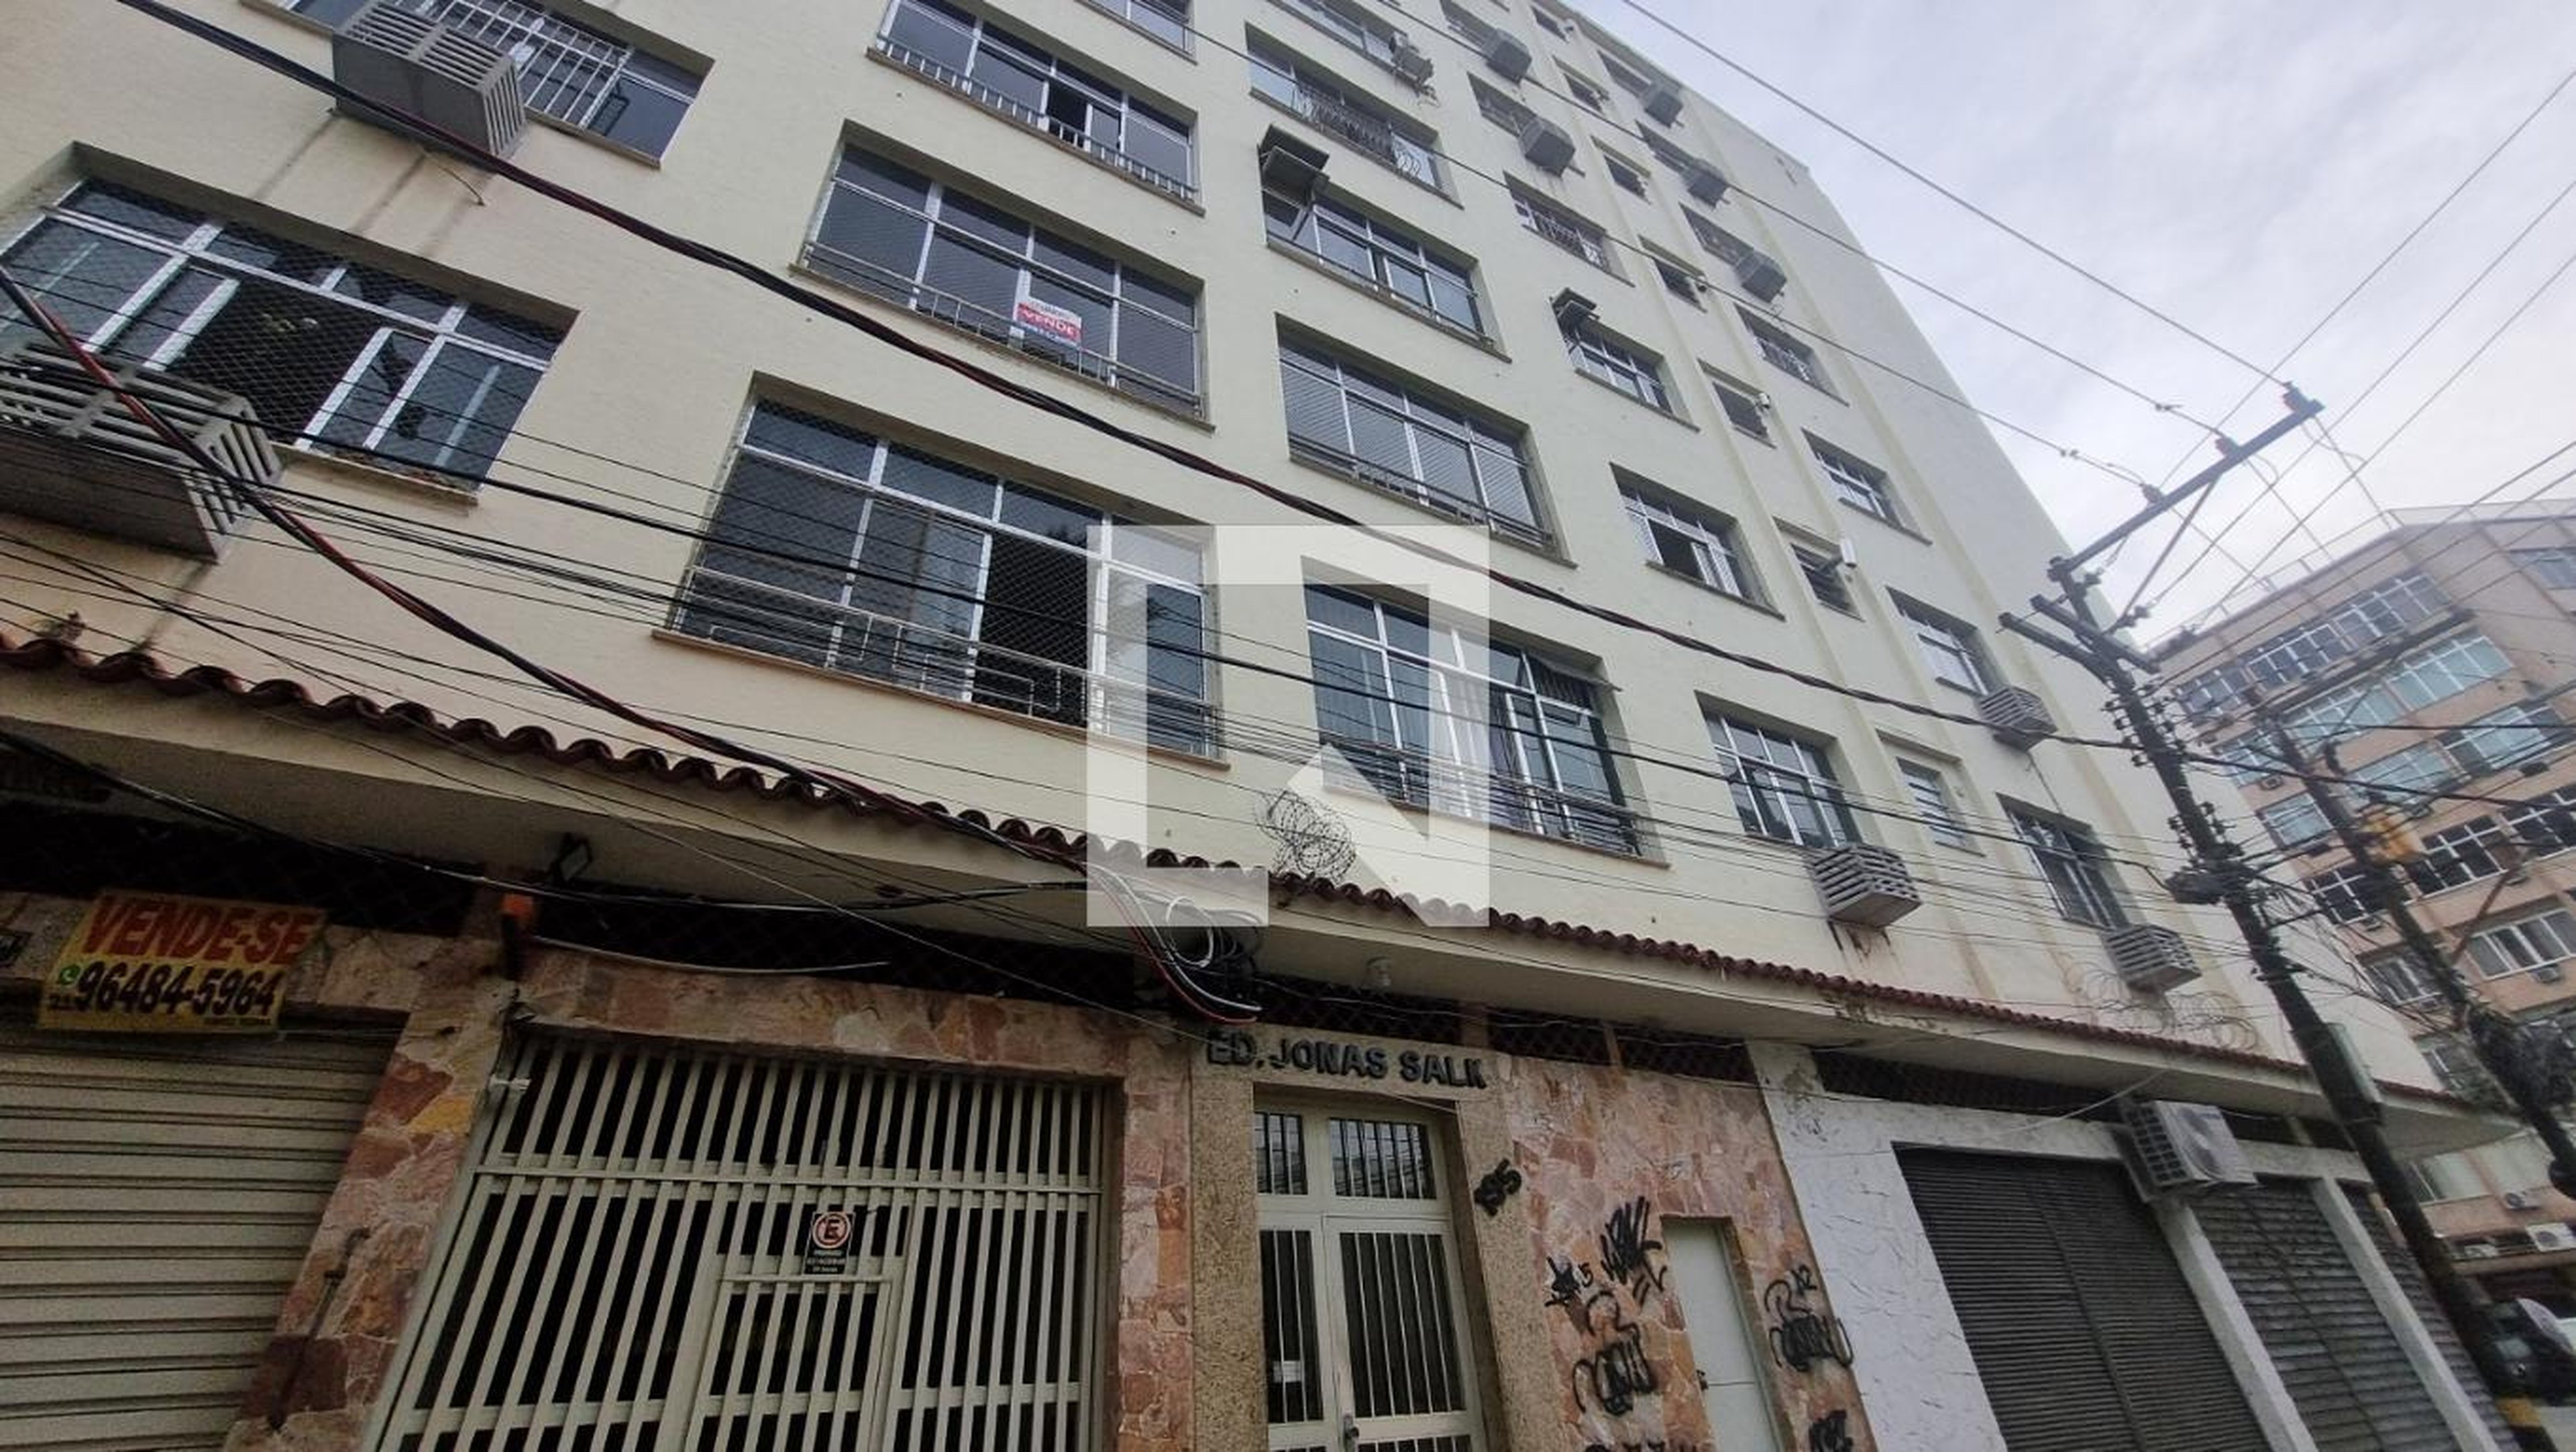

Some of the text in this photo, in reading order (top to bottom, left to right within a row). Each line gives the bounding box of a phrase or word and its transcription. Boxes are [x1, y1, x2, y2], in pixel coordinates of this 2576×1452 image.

[81, 896, 319, 965] VENDE-SE
[79, 961, 284, 1015] 96484-5964
[1207, 1027, 1488, 1090] ED. JONAS SALK
